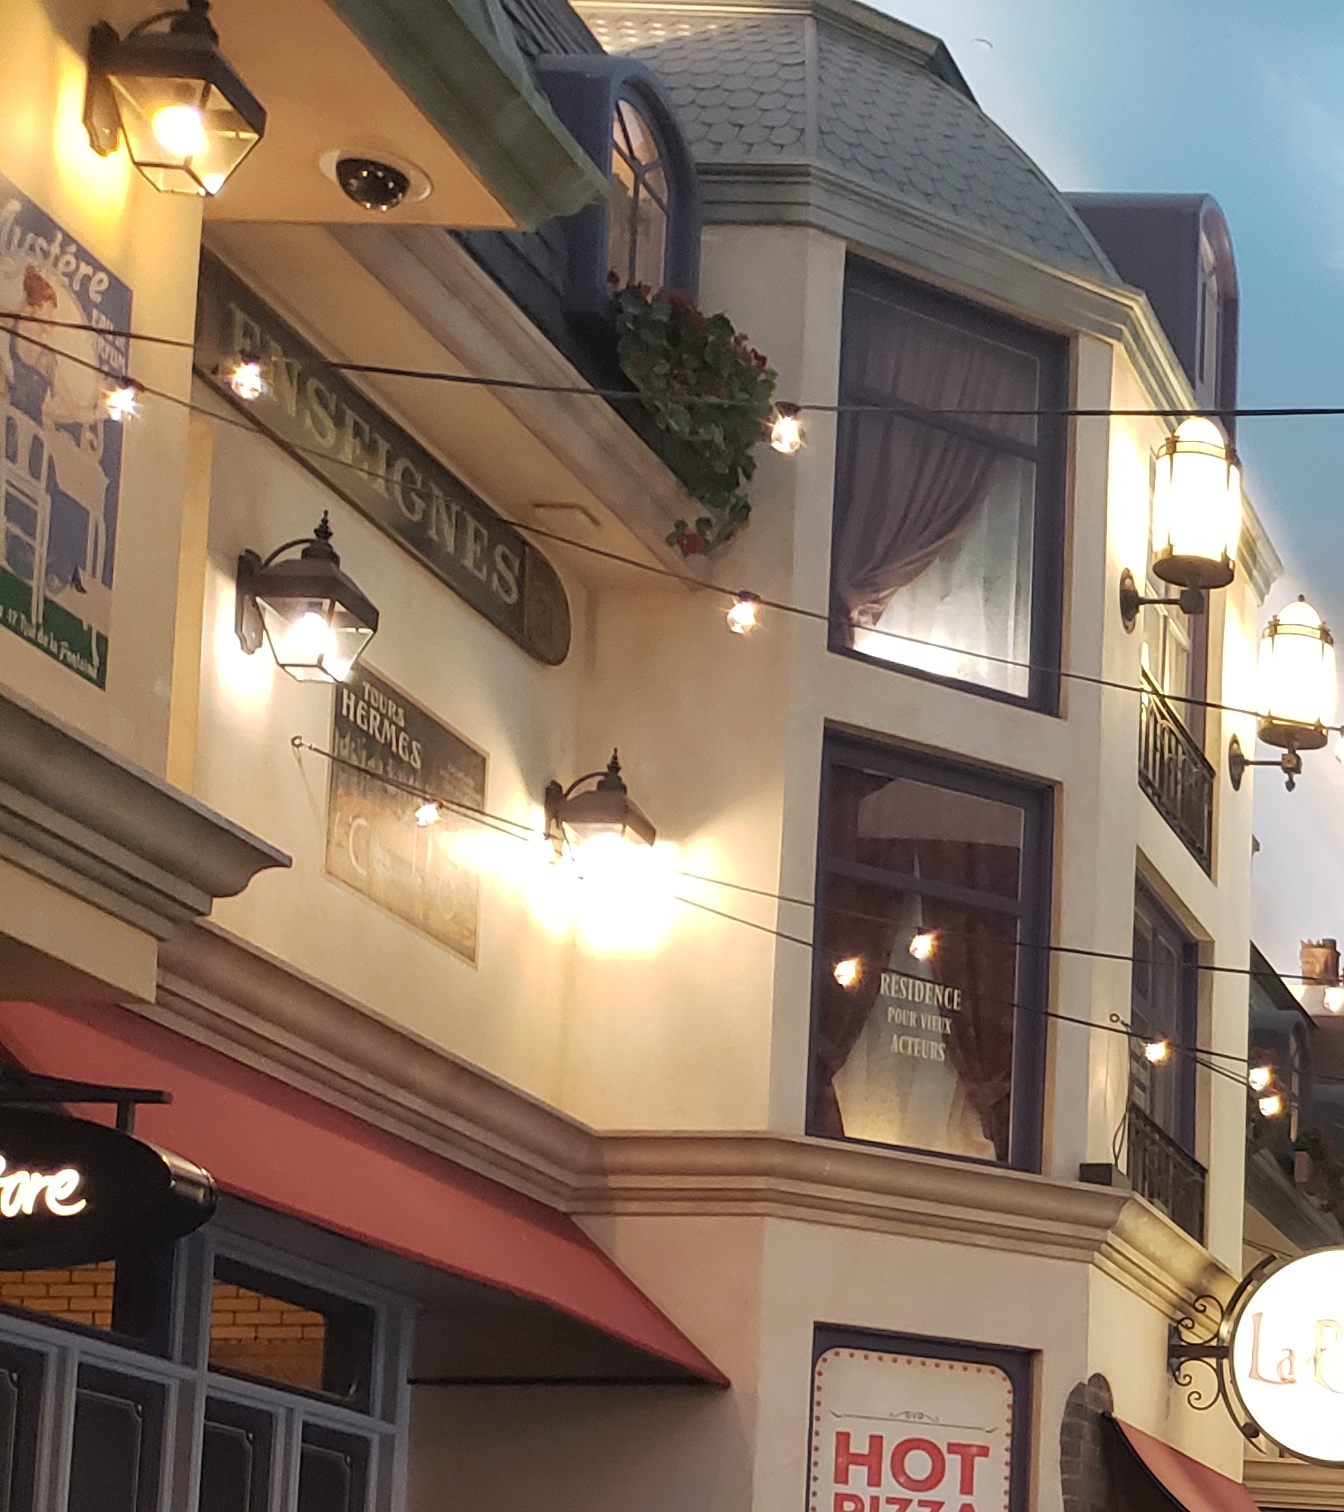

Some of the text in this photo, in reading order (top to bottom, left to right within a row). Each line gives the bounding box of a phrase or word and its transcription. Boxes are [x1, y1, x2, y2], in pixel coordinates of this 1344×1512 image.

[363, 681, 405, 727] TOURS
[341, 688, 422, 770] HERMES
[880, 973, 962, 1010] RESIDENCE
[887, 1006, 953, 1035] POUR VIEUX
[891, 1034, 946, 1062] ACTEURS
[1248, 1312, 1297, 1385] La
[834, 1431, 990, 1496] HOT
